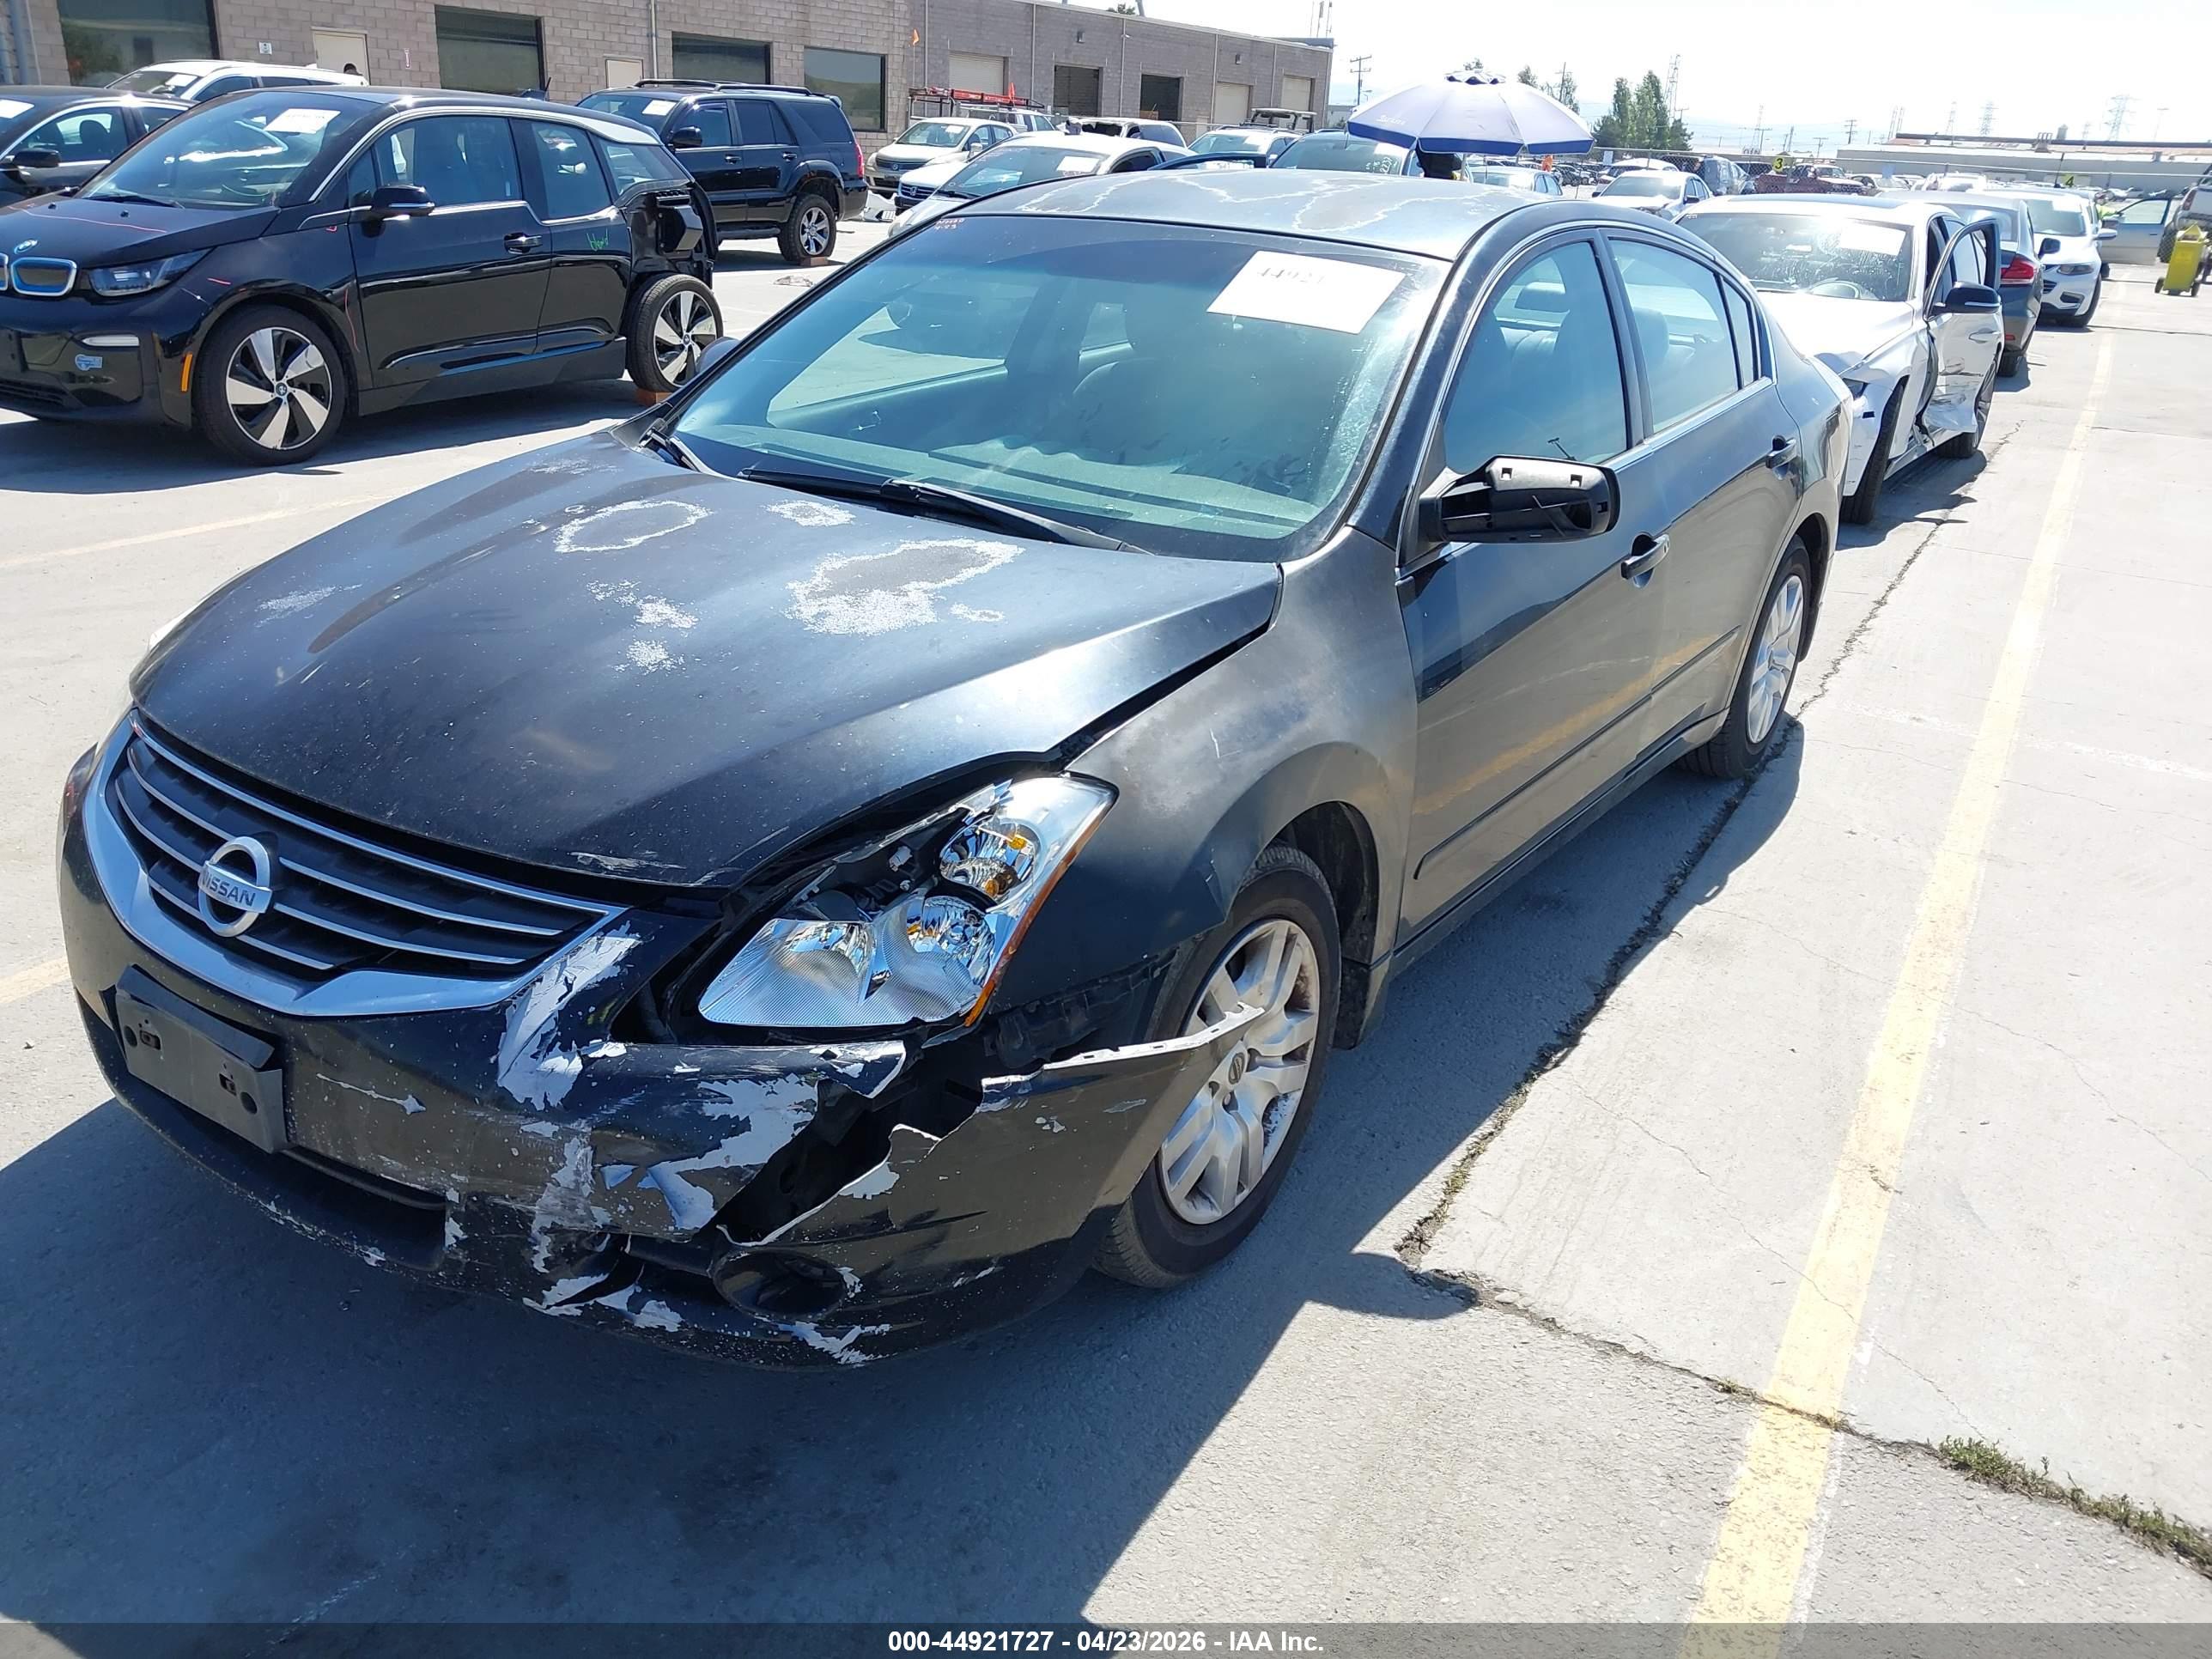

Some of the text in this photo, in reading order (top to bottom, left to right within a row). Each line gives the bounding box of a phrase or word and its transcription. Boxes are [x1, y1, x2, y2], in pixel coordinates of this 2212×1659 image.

[1774, 157, 1784, 170] 3
[2065, 175, 2075, 188] 4
[201, 871, 257, 908] NISSAN
